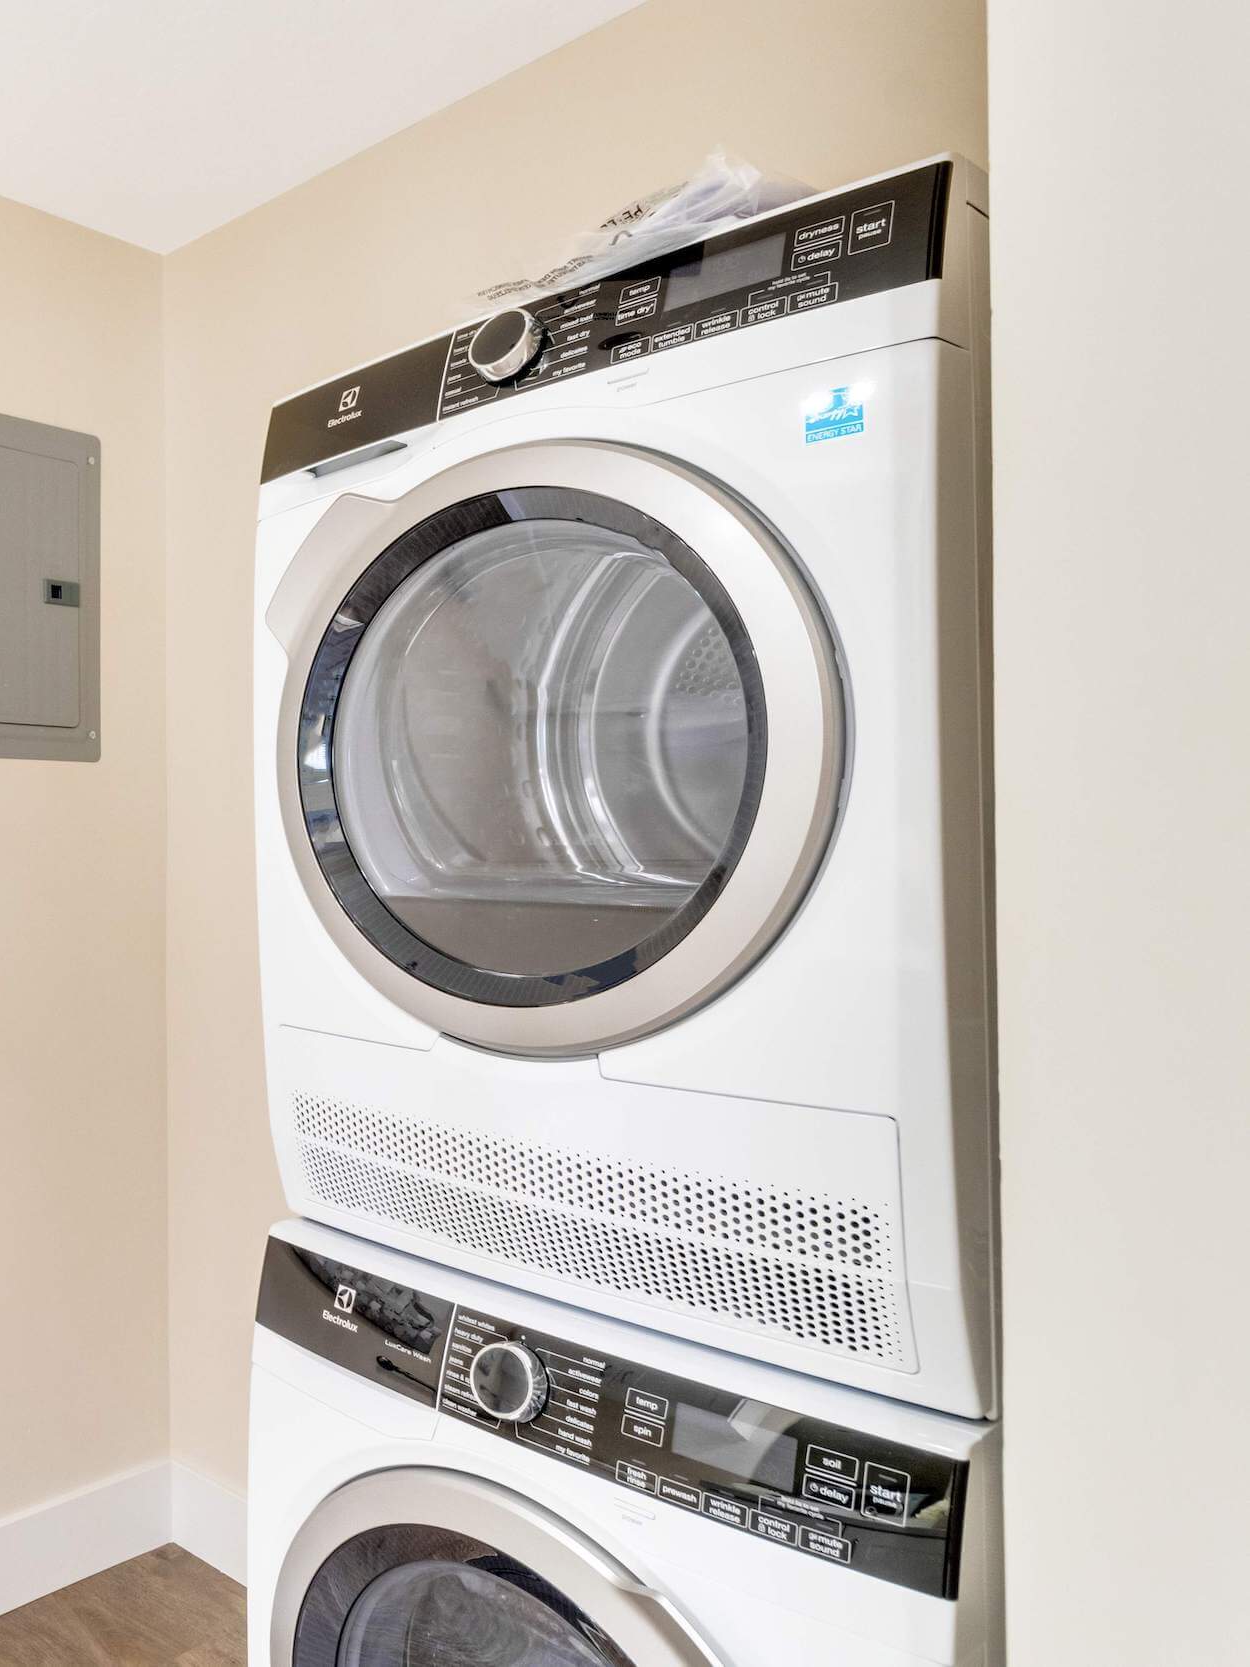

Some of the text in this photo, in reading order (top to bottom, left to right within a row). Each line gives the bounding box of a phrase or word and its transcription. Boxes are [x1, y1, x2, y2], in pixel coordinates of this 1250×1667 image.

[798, 223, 840, 241] dryness
[856, 218, 887, 235] start
[858, 229, 882, 240] pause
[807, 248, 836, 261] delay
[629, 284, 651, 296] temp
[808, 286, 831, 299] mute
[748, 301, 779, 316] control
[798, 295, 828, 308] sound
[580, 312, 594, 323] load
[617, 309, 636, 320] time
[701, 314, 732, 329] wrinkle
[757, 310, 777, 320] lock
[566, 330, 591, 342] fast dry
[654, 326, 691, 343] extended
[701, 322, 731, 336] release
[627, 341, 642, 351] eco
[658, 335, 686, 348] tumble
[619, 348, 642, 360] mode
[327, 410, 363, 429] Electrolux
[806, 424, 862, 442] ENERGY STAR
[322, 1309, 359, 1333] Electrolux
[384, 1339, 432, 1364] LuxCare Wash
[582, 1356, 606, 1370] normal
[567, 1368, 603, 1384] activewear
[578, 1387, 600, 1400] colors
[566, 1399, 597, 1417] fast wash
[635, 1396, 659, 1412] temp
[557, 1427, 593, 1448] hand wash
[633, 1424, 653, 1438] spin
[822, 1457, 842, 1470] soil
[627, 1466, 648, 1481] fresh
[626, 1476, 647, 1489] rinse
[662, 1484, 698, 1504] prewash
[819, 1486, 850, 1504] delay
[869, 1484, 902, 1502] start
[710, 1498, 741, 1515] wrinkle
[709, 1506, 741, 1524] release
[757, 1515, 790, 1533] control
[767, 1527, 788, 1541] lock
[809, 1541, 840, 1558] sound
[818, 1534, 843, 1550] mute
